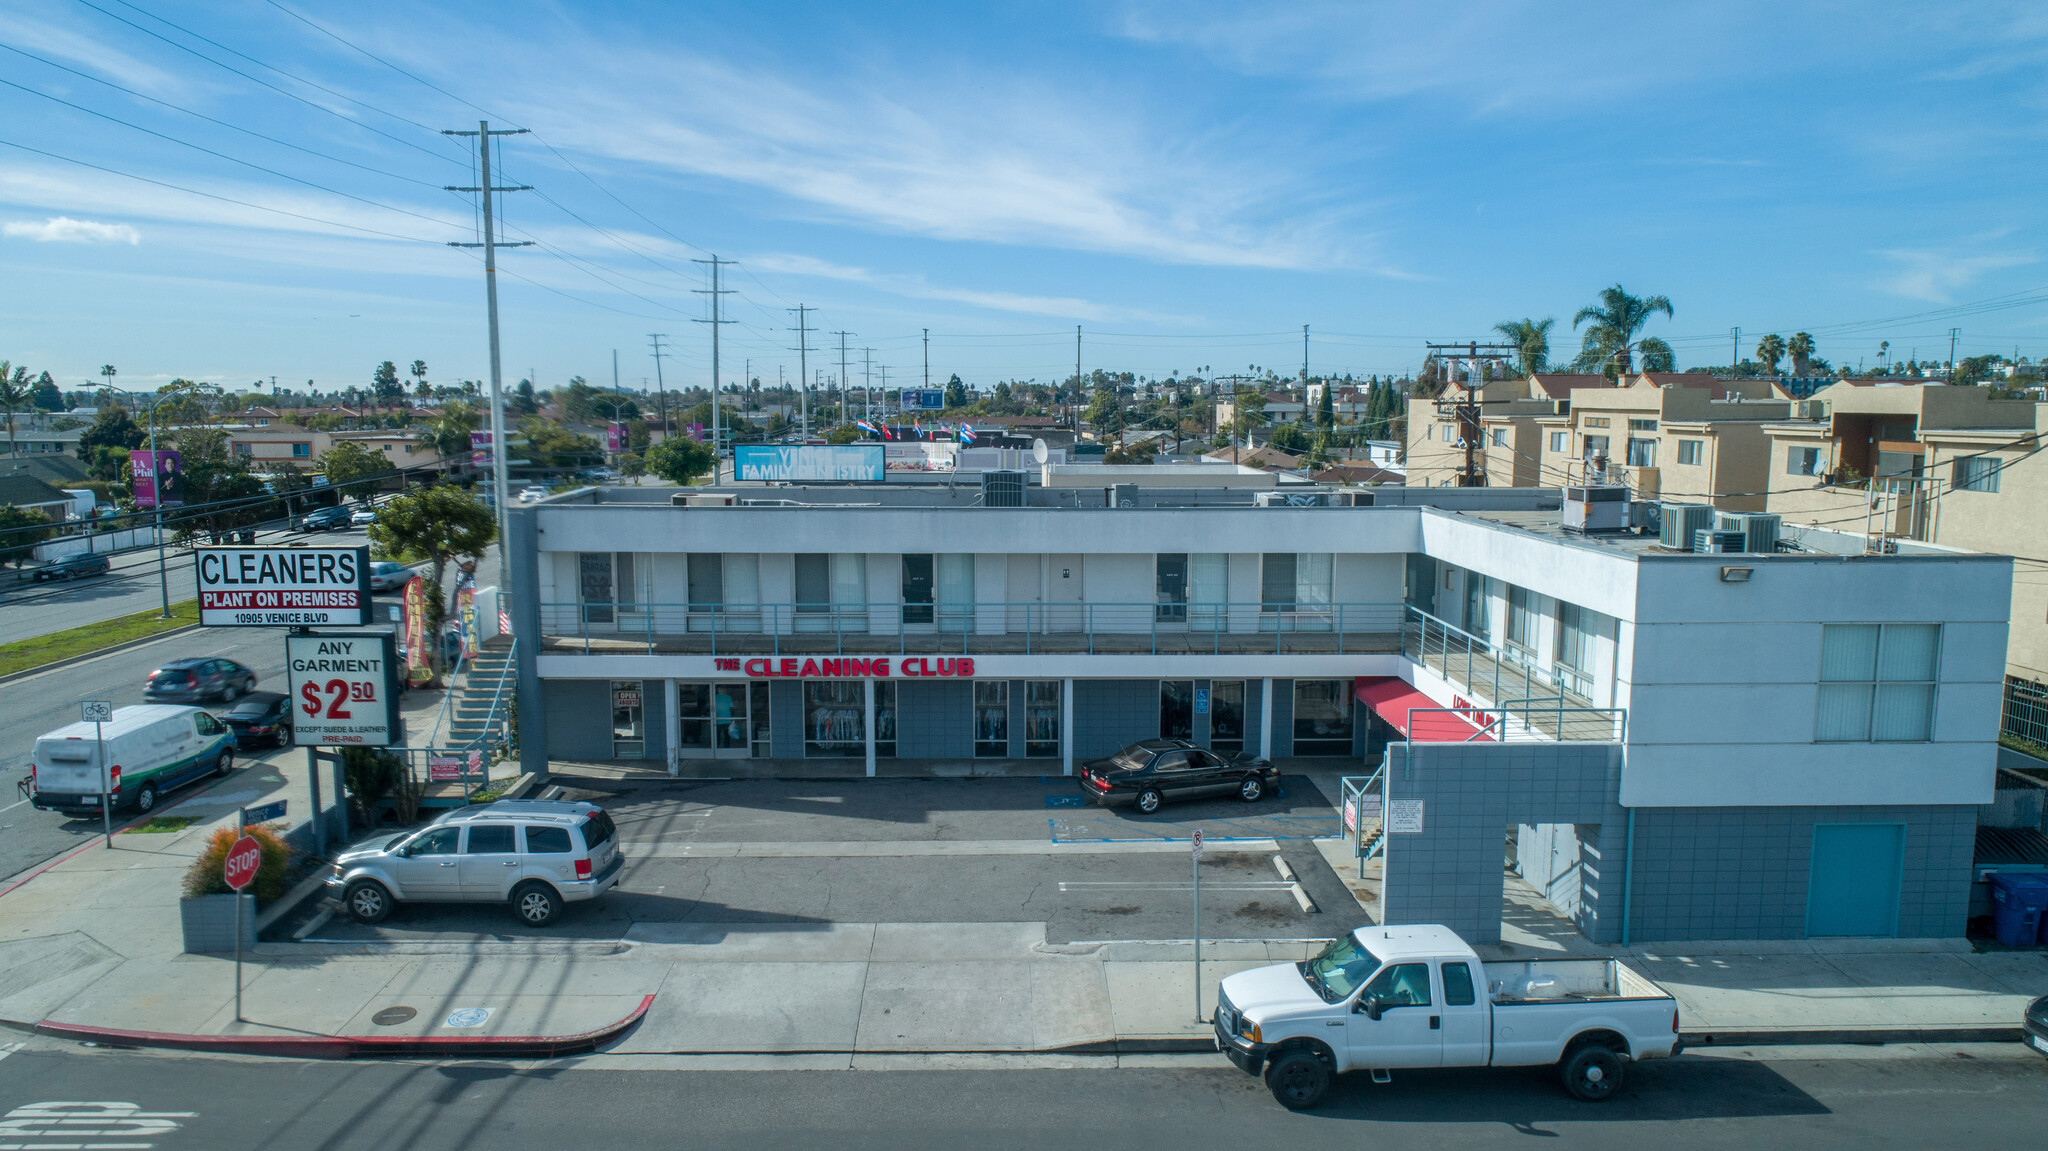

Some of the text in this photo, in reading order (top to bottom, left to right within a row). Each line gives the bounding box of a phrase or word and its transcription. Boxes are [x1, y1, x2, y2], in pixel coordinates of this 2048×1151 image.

[132, 459, 146, 468] LA
[133, 467, 154, 477] Phil
[742, 464, 875, 480] FAMILY DENTISTRY
[201, 553, 356, 585] CLEANERS
[203, 591, 357, 607] PLANT ON PREMISES
[234, 612, 329, 623] 10905 VENICE BLVD
[317, 641, 353, 655] ANY
[292, 659, 380, 672] GARMENT
[714, 657, 975, 677] THE CLEANING CLUB
[322, 735, 363, 743] PRE-PAID
[247, 808, 270, 820] Venice
[228, 848, 258, 877] STOP
